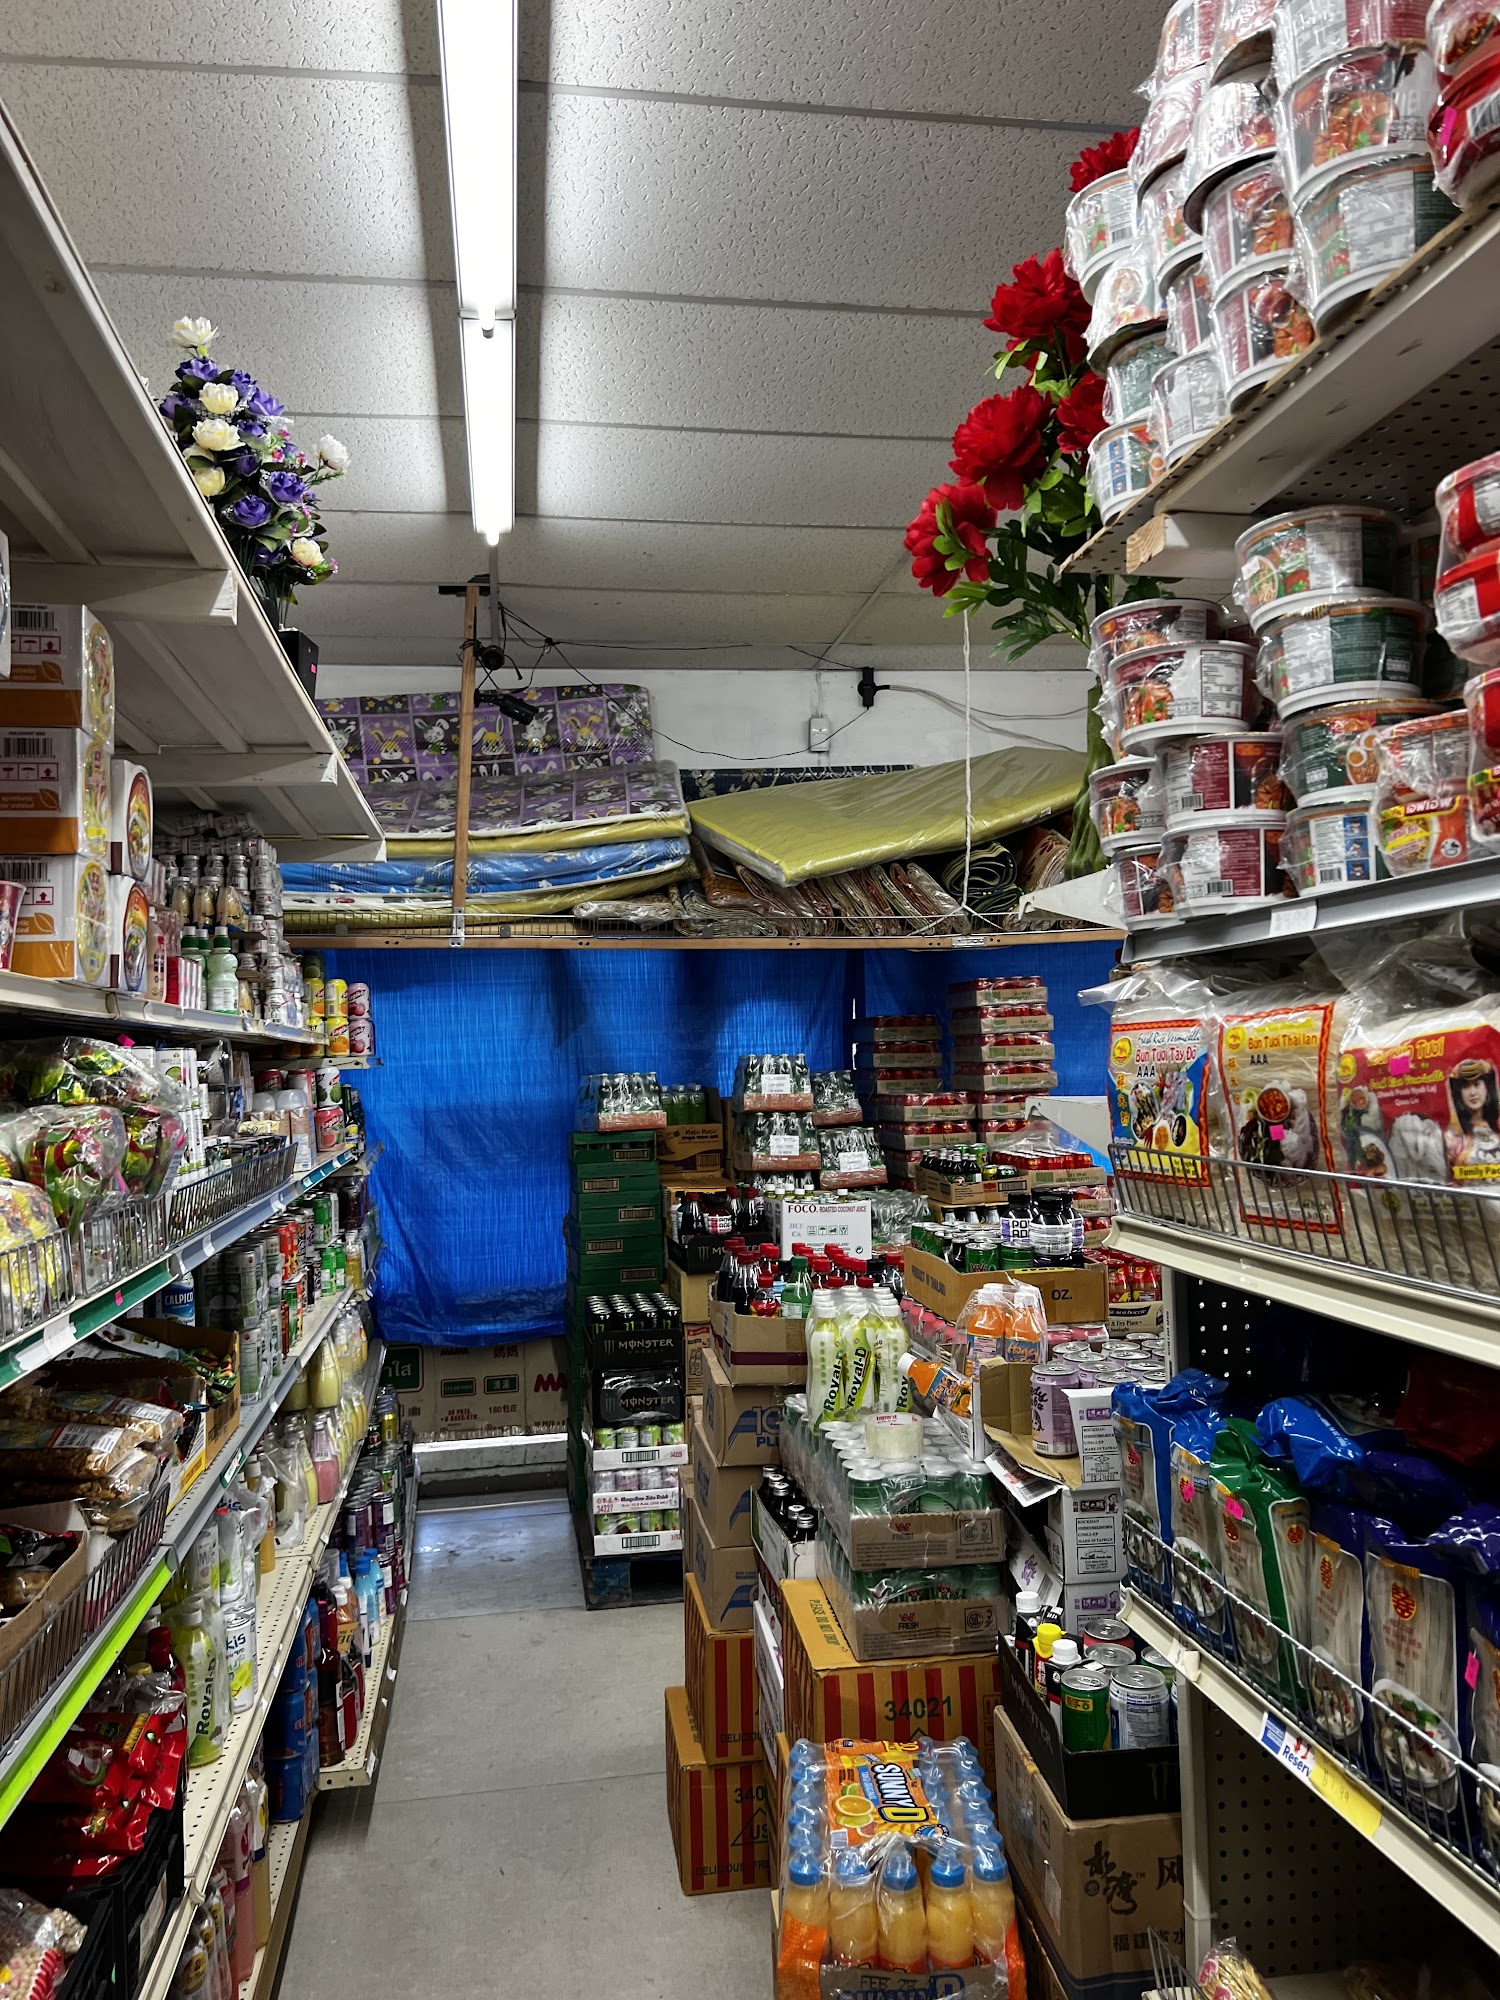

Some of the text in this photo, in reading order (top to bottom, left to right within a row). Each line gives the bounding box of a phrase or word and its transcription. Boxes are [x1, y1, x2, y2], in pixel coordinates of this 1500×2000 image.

[1250, 1054, 1269, 1066] AAA
[1136, 1065, 1156, 1078] AAA
[1458, 1165, 1500, 1178] Family Pac
[788, 1204, 817, 1213] FOCO
[1011, 1219, 1029, 1229] PO
[1012, 1229, 1029, 1239] AD
[911, 1264, 926, 1282] PRODUCT
[164, 1292, 194, 1306] CALPICO
[1052, 1289, 1073, 1299] OZ.
[618, 1338, 675, 1350] MONSTER
[847, 1346, 867, 1408] Royal-D
[619, 1395, 675, 1407] MONSTER
[808, 1599, 826, 1618] PLEASE
[898, 1622, 919, 1630] FRESH
[884, 1695, 952, 1722] 34021
[871, 1762, 918, 1808] SUNNY
[696, 1862, 745, 1877] DELICIOUS
